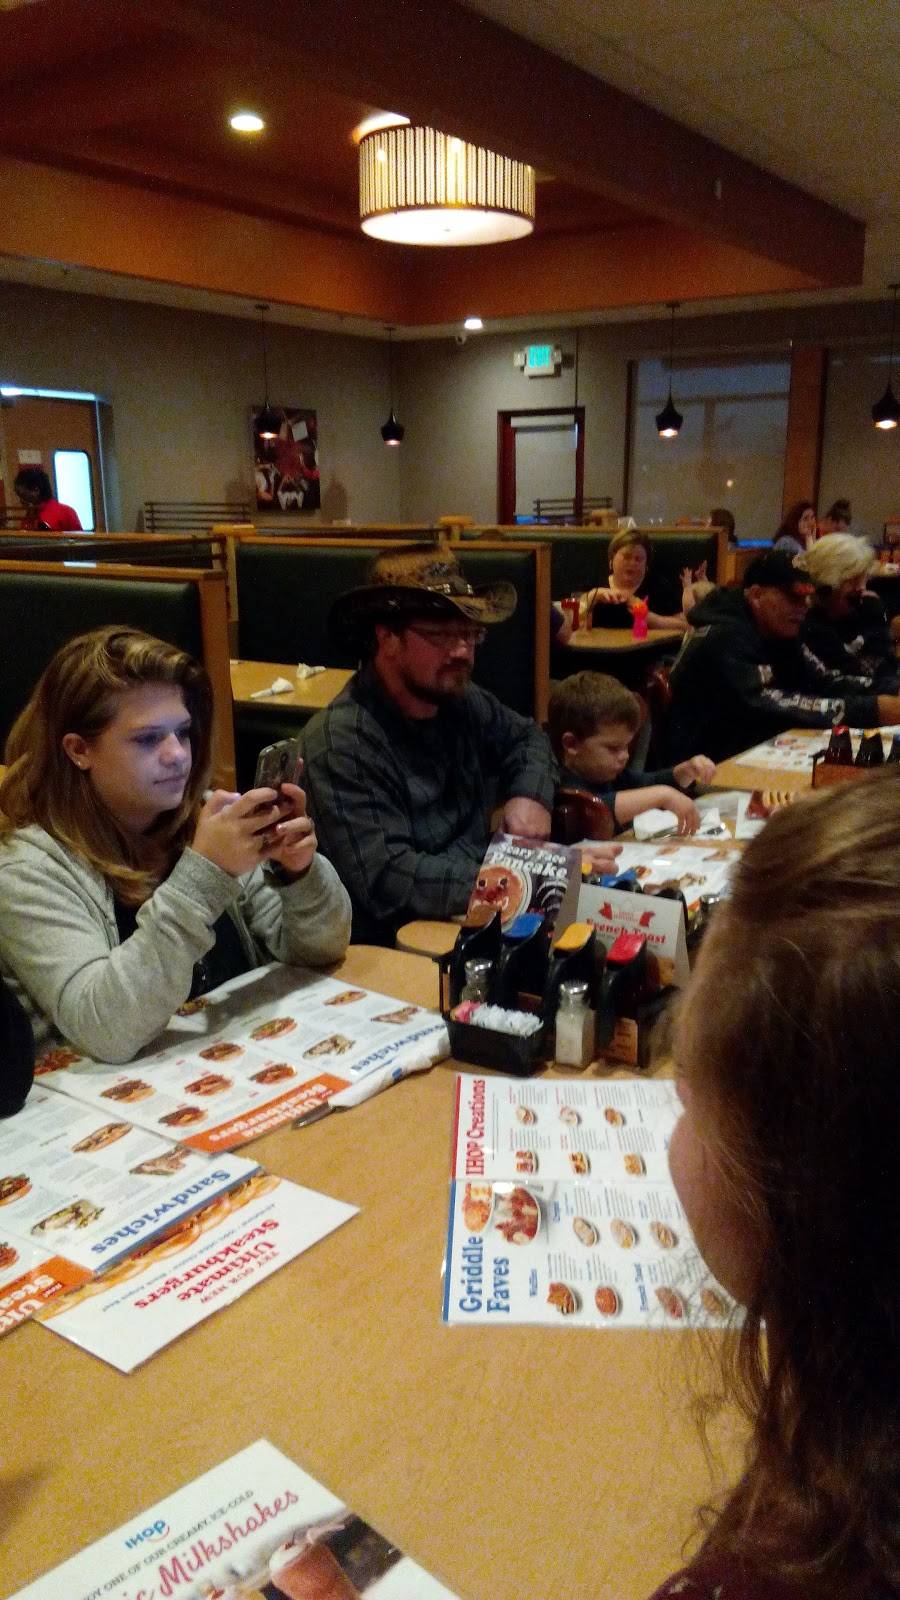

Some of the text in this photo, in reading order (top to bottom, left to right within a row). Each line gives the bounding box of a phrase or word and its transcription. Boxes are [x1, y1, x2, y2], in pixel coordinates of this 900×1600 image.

[489, 851, 568, 880] Pancake
[465, 1079, 486, 1176] IHOP Creations
[91, 1170, 230, 1253] Sandwiches
[134, 1219, 279, 1309] Steakburgers
[177, 1241, 276, 1301] Ultimate
[459, 1236, 483, 1313] Griddle
[487, 1256, 511, 1313] Faves
[143, 1547, 168, 1564] OUR
[158, 1490, 299, 1596] Milkshakes
